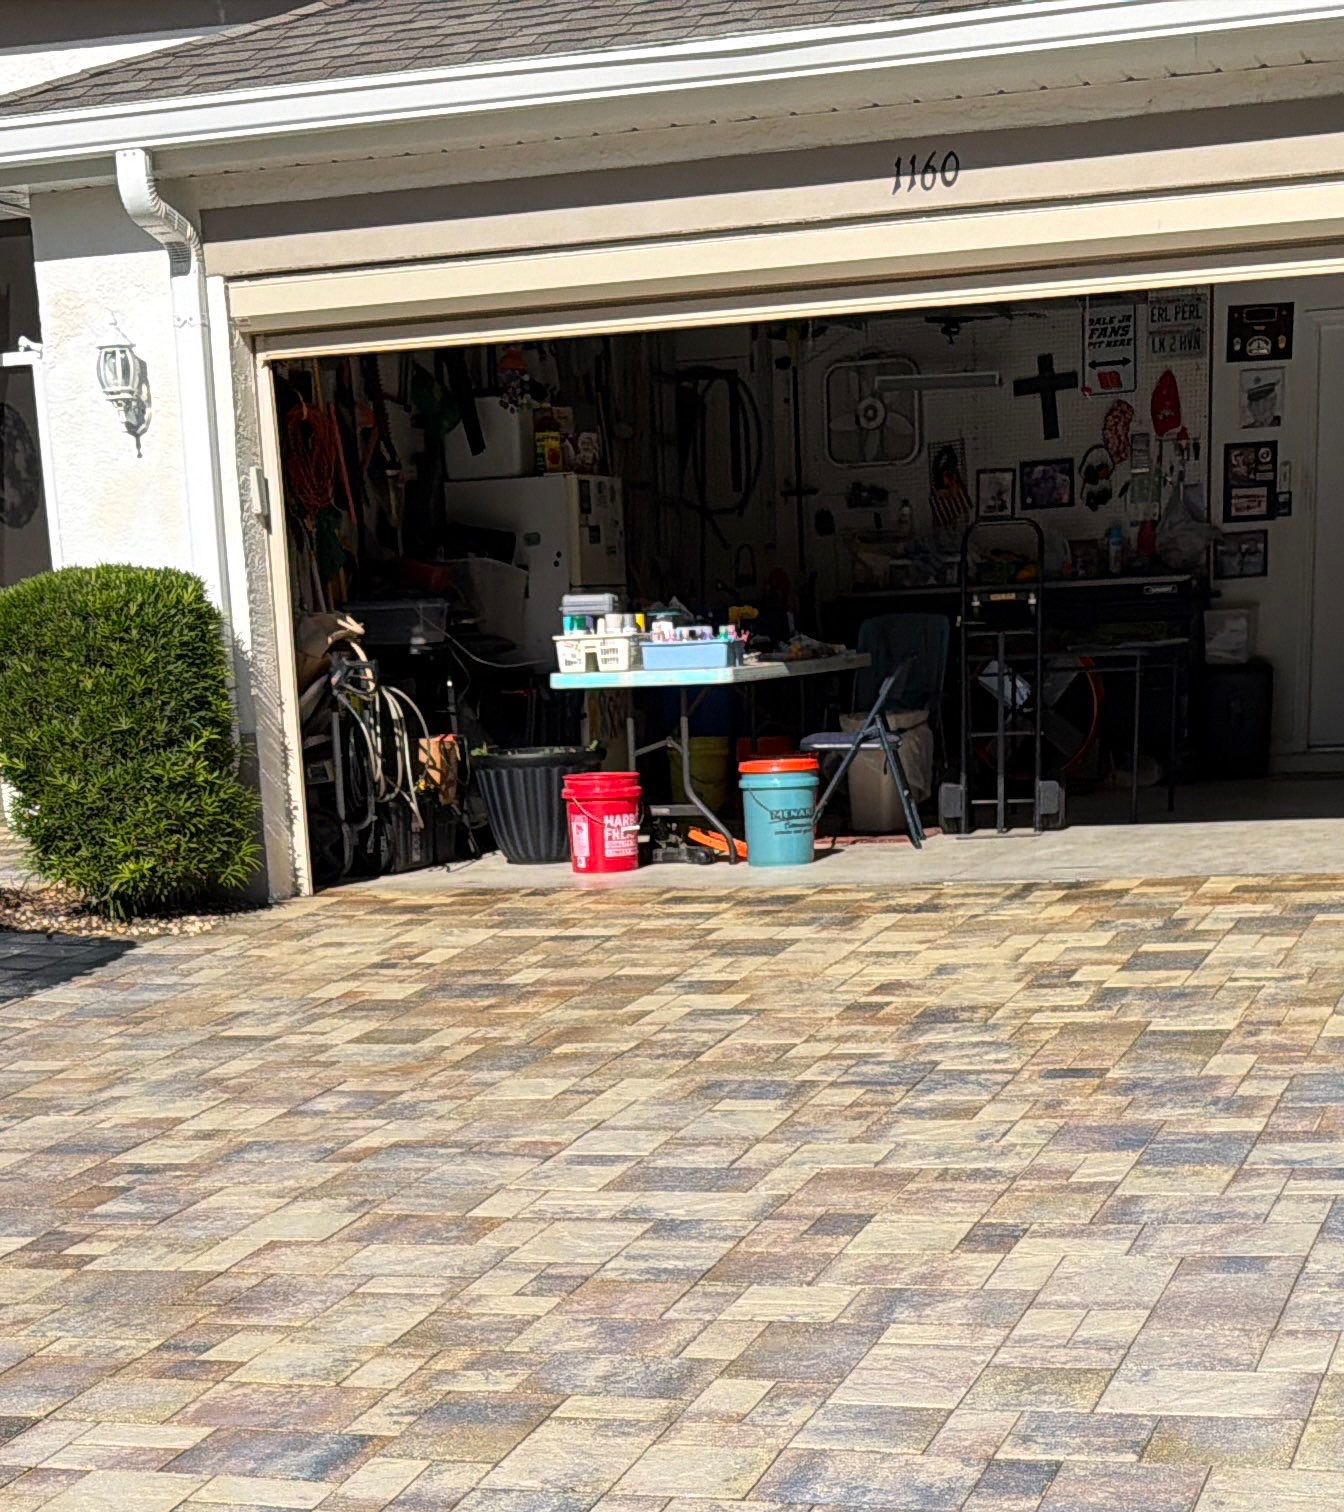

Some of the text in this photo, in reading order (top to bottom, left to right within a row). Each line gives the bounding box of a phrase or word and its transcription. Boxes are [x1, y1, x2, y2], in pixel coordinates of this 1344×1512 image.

[891, 150, 960, 196] 1160
[1150, 303, 1203, 323] ERL PERL
[1088, 316, 1116, 327] DALE
[1088, 325, 1131, 340] FANS
[1105, 338, 1133, 349] HERE
[770, 807, 813, 821] MENAR
